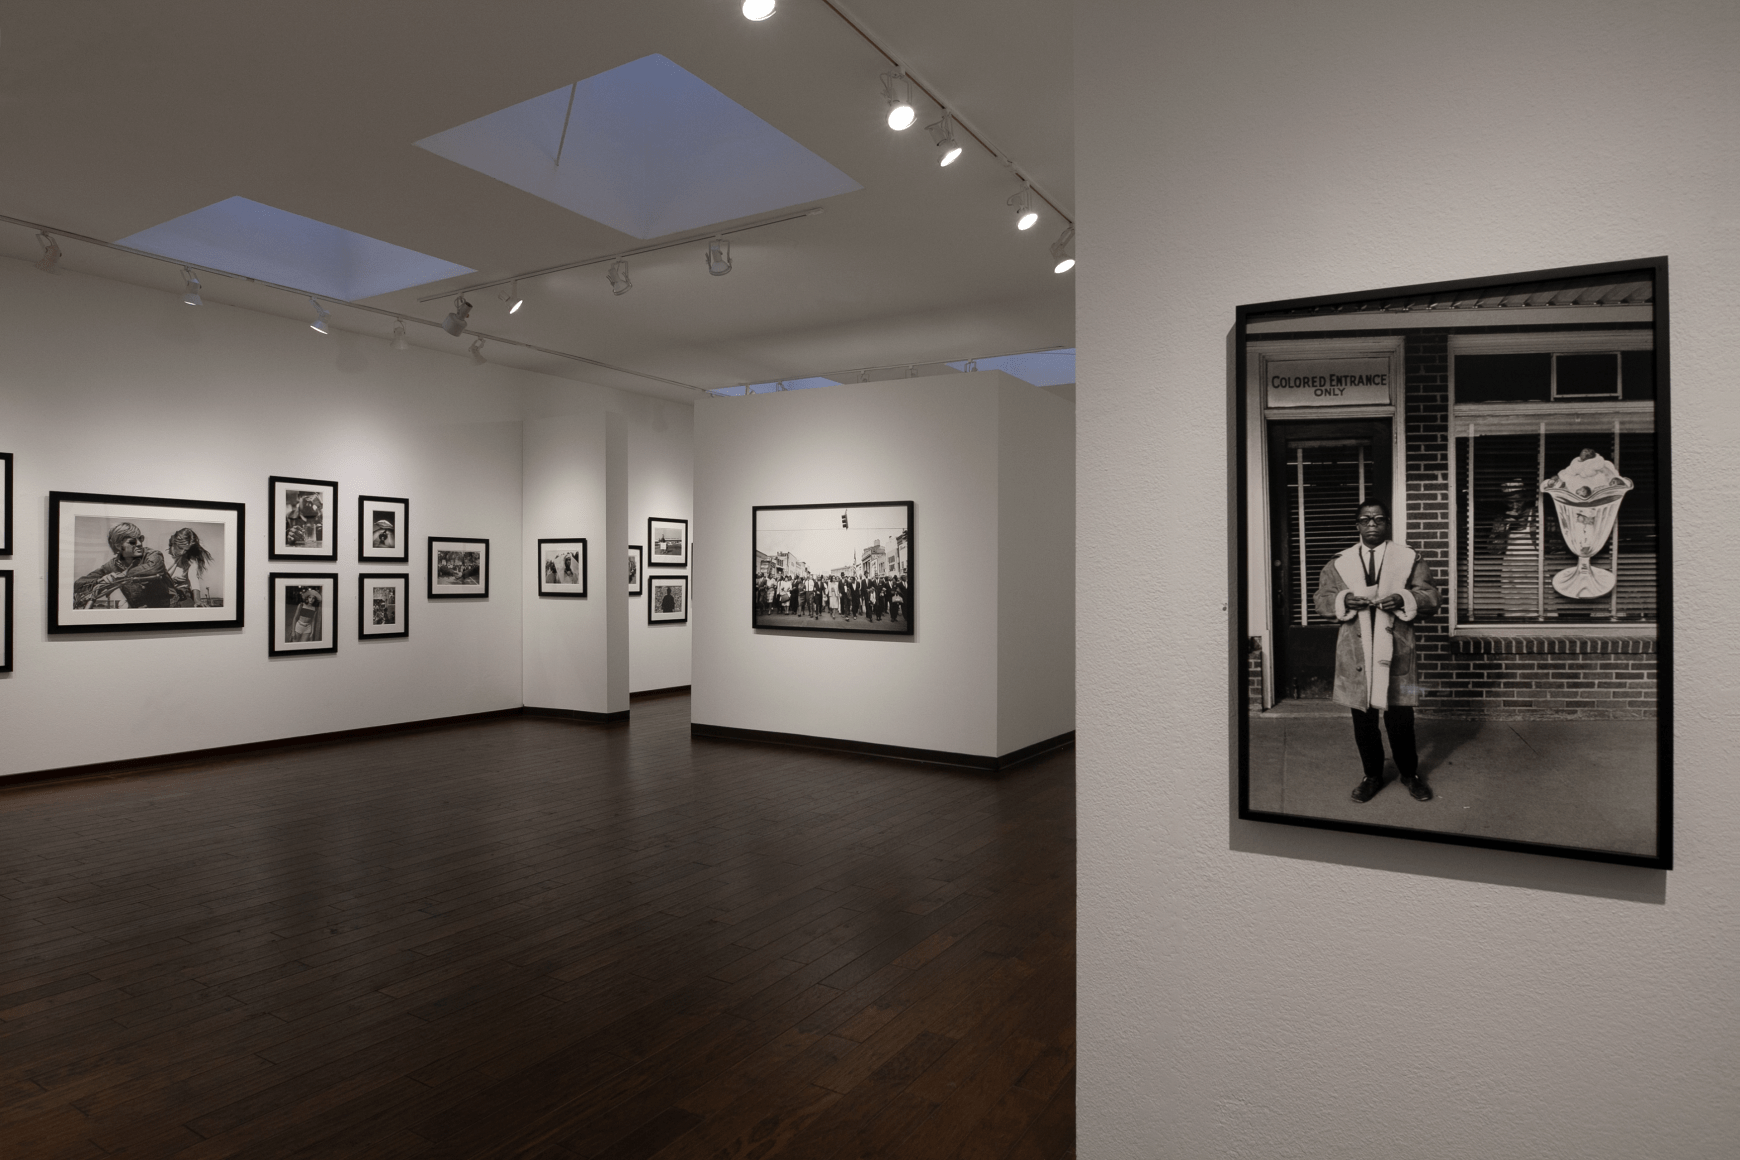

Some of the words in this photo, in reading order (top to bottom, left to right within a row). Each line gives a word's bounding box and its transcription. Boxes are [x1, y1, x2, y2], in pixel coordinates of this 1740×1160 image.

[1271, 375, 1326, 389] COLORED
[1329, 373, 1388, 388] ENTRANCE
[1313, 387, 1346, 397] ONLY
